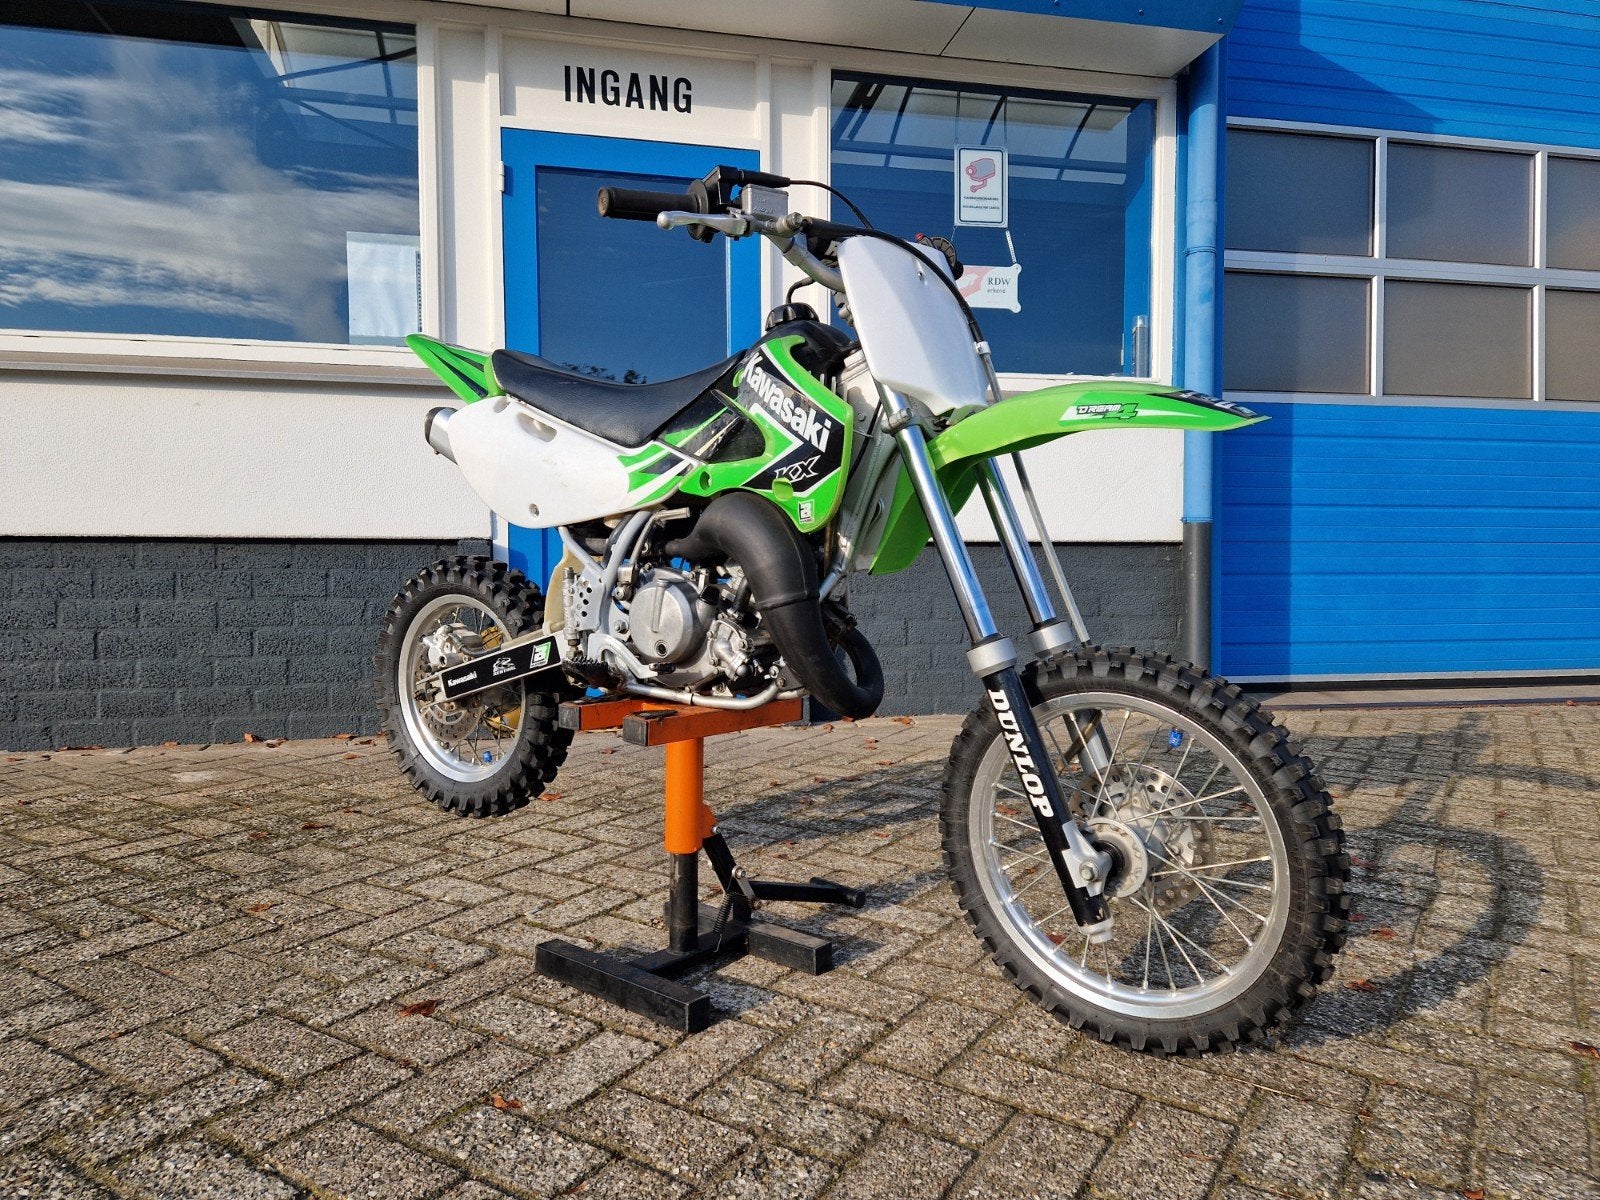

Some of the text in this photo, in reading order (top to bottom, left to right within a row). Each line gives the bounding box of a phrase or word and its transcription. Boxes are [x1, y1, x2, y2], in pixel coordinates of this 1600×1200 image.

[564, 65, 692, 114] INGANG
[988, 277, 1011, 286] RDW
[743, 351, 833, 453] Kawasaki
[773, 454, 822, 483] KX
[448, 671, 477, 687] Kawasaki
[987, 688, 1054, 818] DUNLOP
